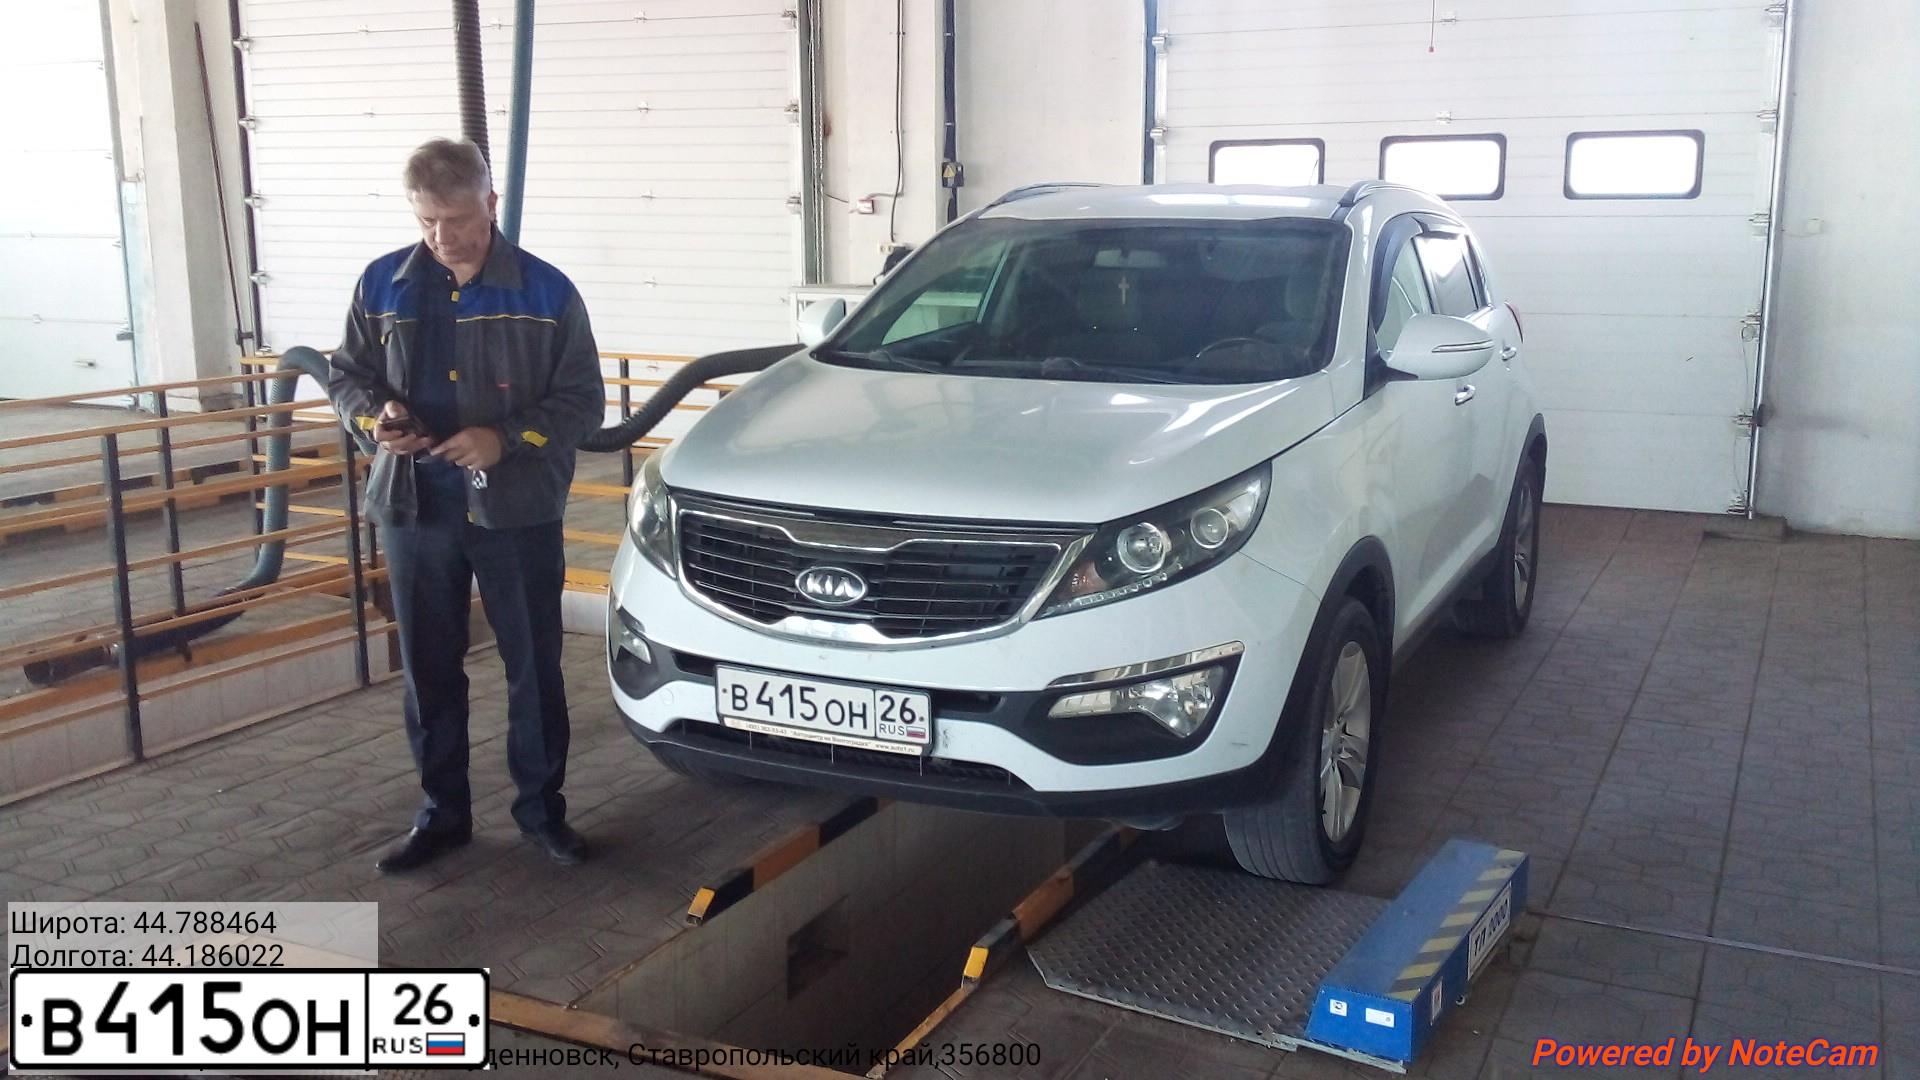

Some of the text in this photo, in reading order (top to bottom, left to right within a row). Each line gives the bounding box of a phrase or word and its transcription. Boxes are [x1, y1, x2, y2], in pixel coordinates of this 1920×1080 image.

[806, 573, 857, 598] KIA
[731, 681, 916, 730] В415ОН 26
[879, 723, 905, 736] RUS
